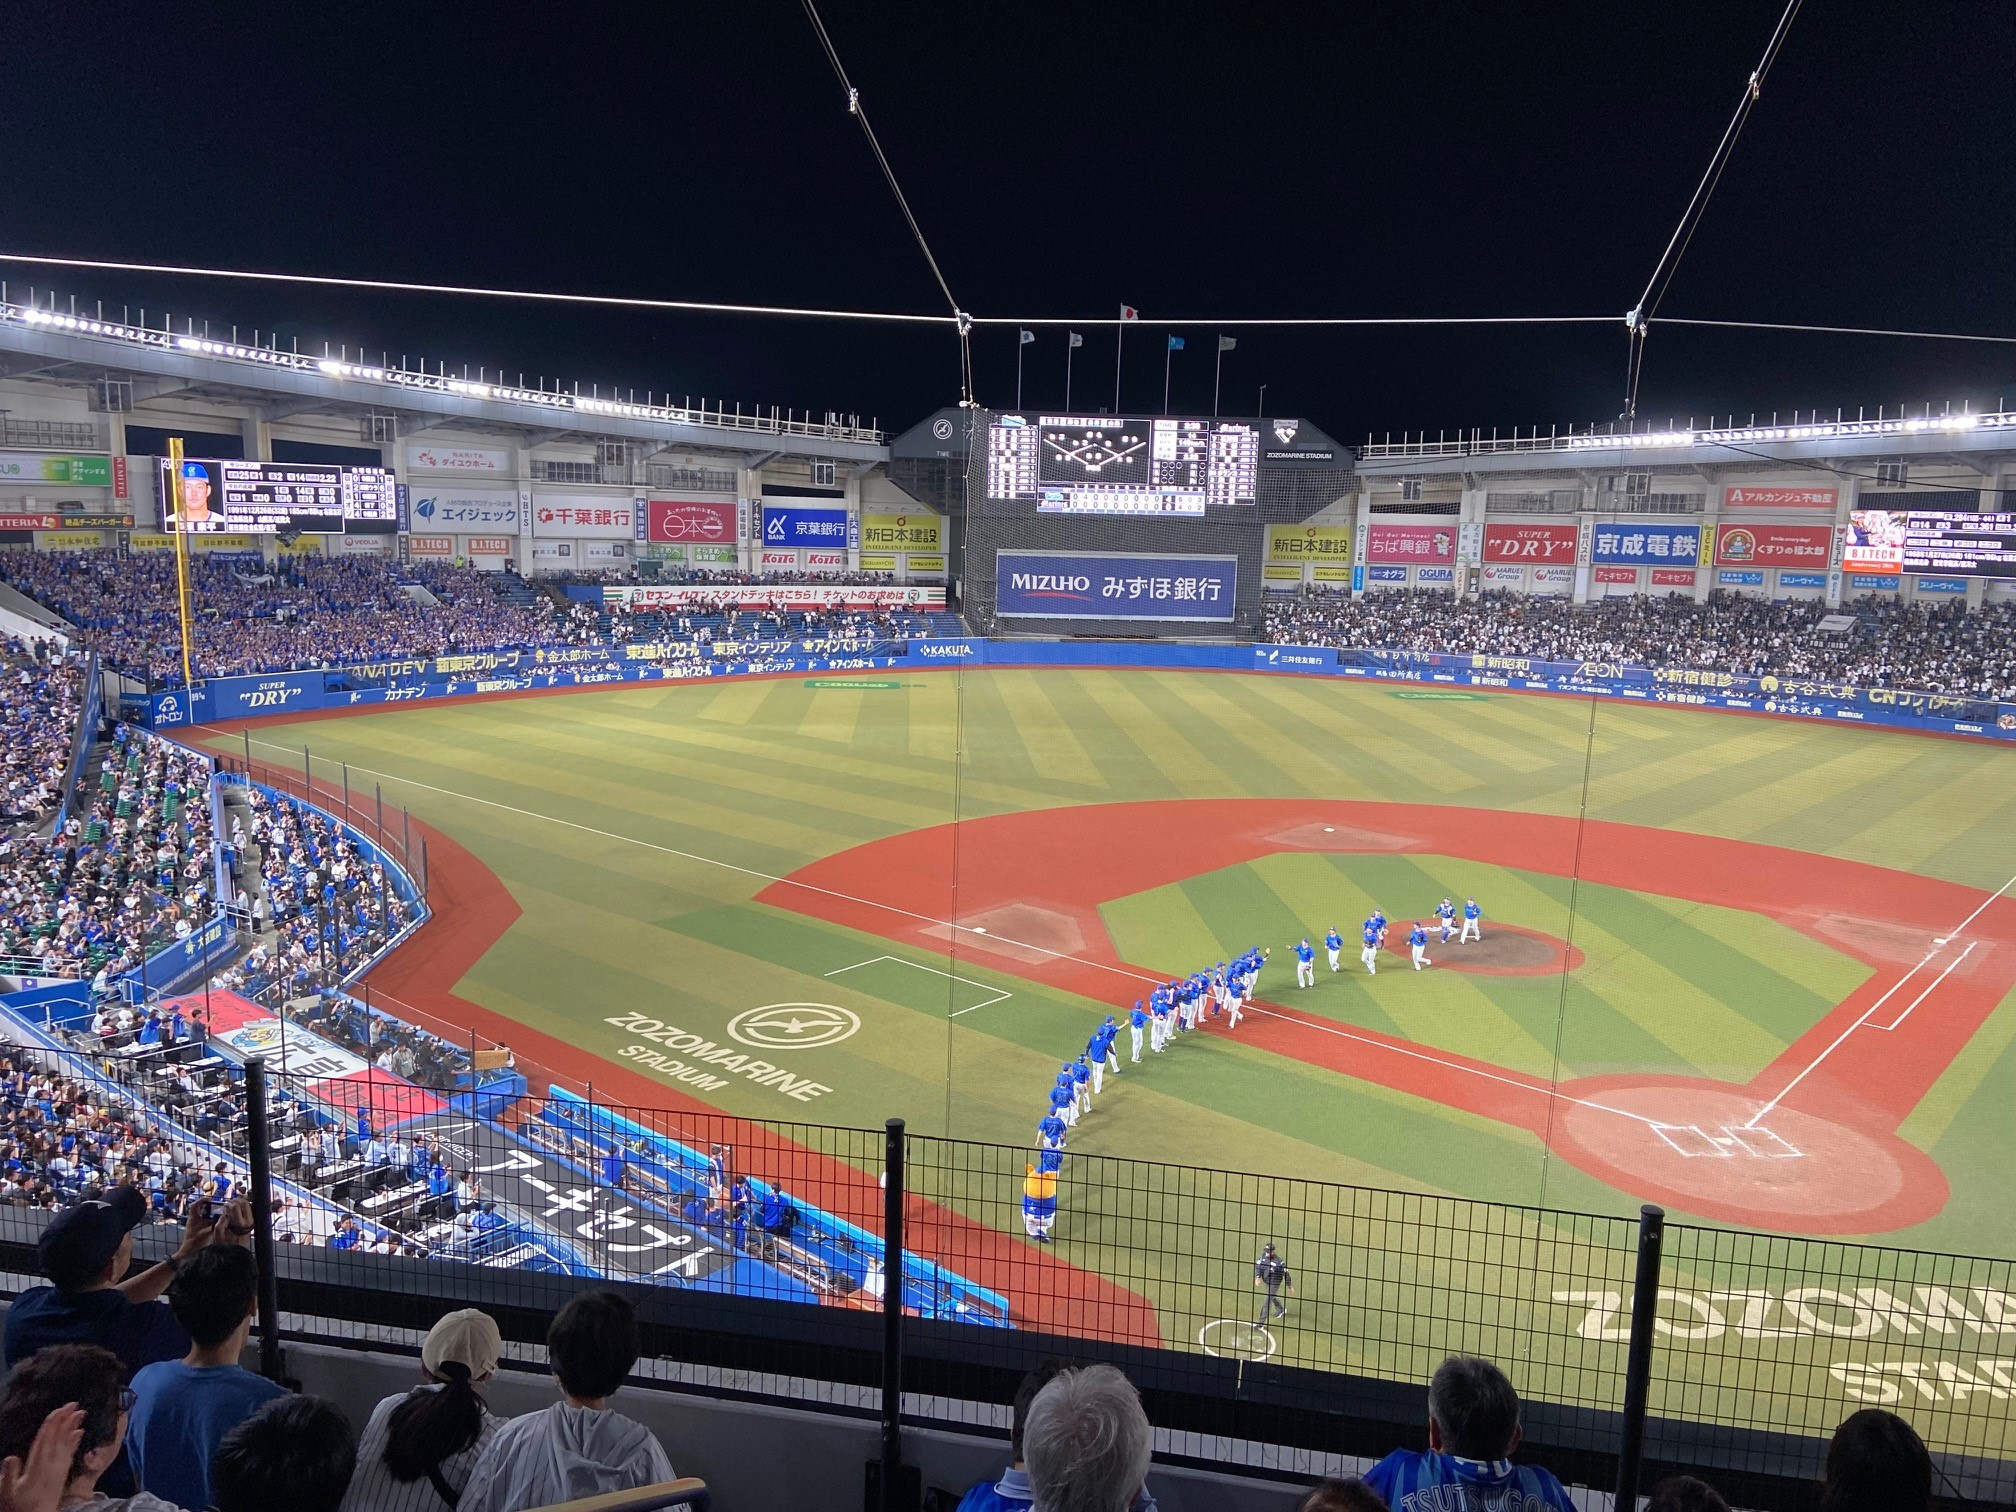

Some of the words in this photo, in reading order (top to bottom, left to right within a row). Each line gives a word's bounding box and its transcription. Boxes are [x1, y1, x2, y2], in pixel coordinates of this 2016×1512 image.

[1745, 492, 1833, 503] アルカンジュ不動産
[442, 507, 517, 522] エイジェック
[522, 502, 530, 527] HTS
[555, 508, 630, 526] 千葉銀行
[753, 500, 761, 538] アーキセプト
[795, 521, 845, 536] 京葉銀行
[865, 528, 937, 543] 新日本建設
[1516, 530, 1551, 539] SUPER
[411, 539, 449, 549] B.I.TECH
[471, 540, 507, 549] B.I.TECH
[1273, 538, 1348, 554] 新日本建設
[1581, 524, 1590, 554] 京成バス
[1596, 533, 1697, 557] 京成電鉄
[1371, 539, 1430, 555] ちば興銀
[1757, 545, 1825, 556] くすりの福太郎
[1851, 549, 1896, 559] B.I.TECH
[1381, 569, 1406, 579] オグラ
[1419, 569, 1453, 578] OGURA
[1597, 571, 1634, 580] アーキセプト
[1654, 573, 1693, 582] アーキセプト
[1011, 573, 1091, 591] MIZUHO
[1102, 576, 1222, 601] みずほ銀行
[823, 590, 905, 600] チケットのお求めは
[547, 648, 610, 663] 金太郎ホーム
[626, 642, 700, 660] 東進ハイスクール
[711, 641, 792, 656] 東京インテリア
[930, 644, 970, 655] KAKUTA
[436, 650, 520, 674] 新東京グループ
[1281, 655, 1323, 665] 三井住友銀行
[1487, 657, 1530, 671] 新昭和
[662, 665, 712, 679] 東進ハイスクール
[747, 662, 796, 673] 東京インテリア
[582, 672, 624, 684] 金太郎ホーム
[1388, 670, 1422, 680] 田所商店
[1481, 677, 1509, 687] 新昭和
[258, 681, 286, 690] SUPER
[476, 677, 532, 693] 新東京グループ
[1782, 680, 1857, 700] 古谷式典
[384, 687, 426, 702] カナデン
[1777, 703, 1824, 716] 古谷式典
[154, 712, 184, 725] オトロン
[602, 1010, 835, 1103] ZOZOMARINE
[616, 1044, 731, 1093] STADIUM
[468, 1149, 716, 1278] アーキセプト
